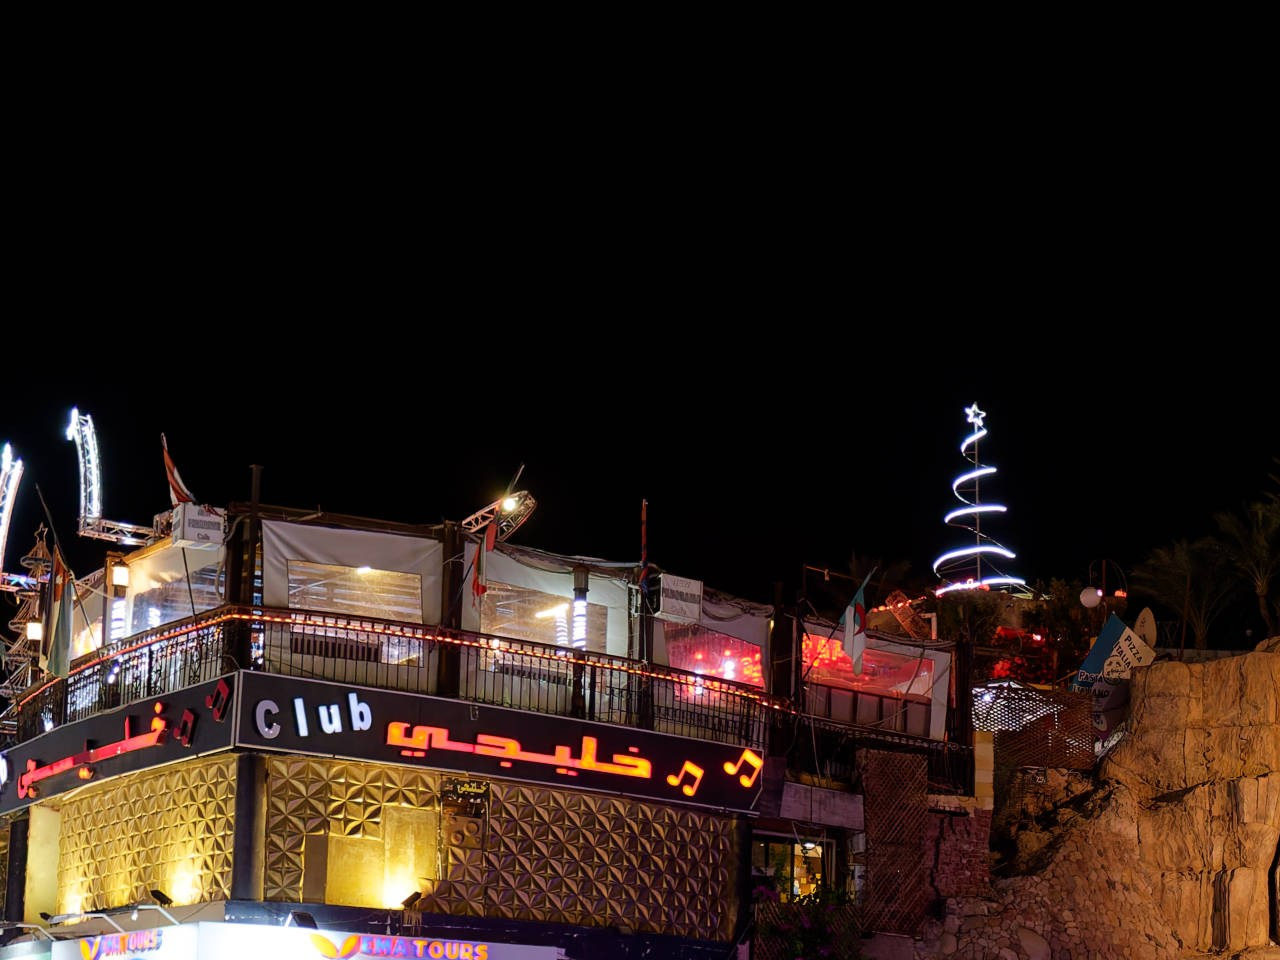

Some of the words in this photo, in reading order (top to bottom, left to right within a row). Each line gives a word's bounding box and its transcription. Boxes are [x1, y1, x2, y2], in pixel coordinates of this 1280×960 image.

[1124, 635, 1142, 663] PIZZA
[386, 721, 652, 779] خليجي
[414, 940, 488, 960] TOURS
